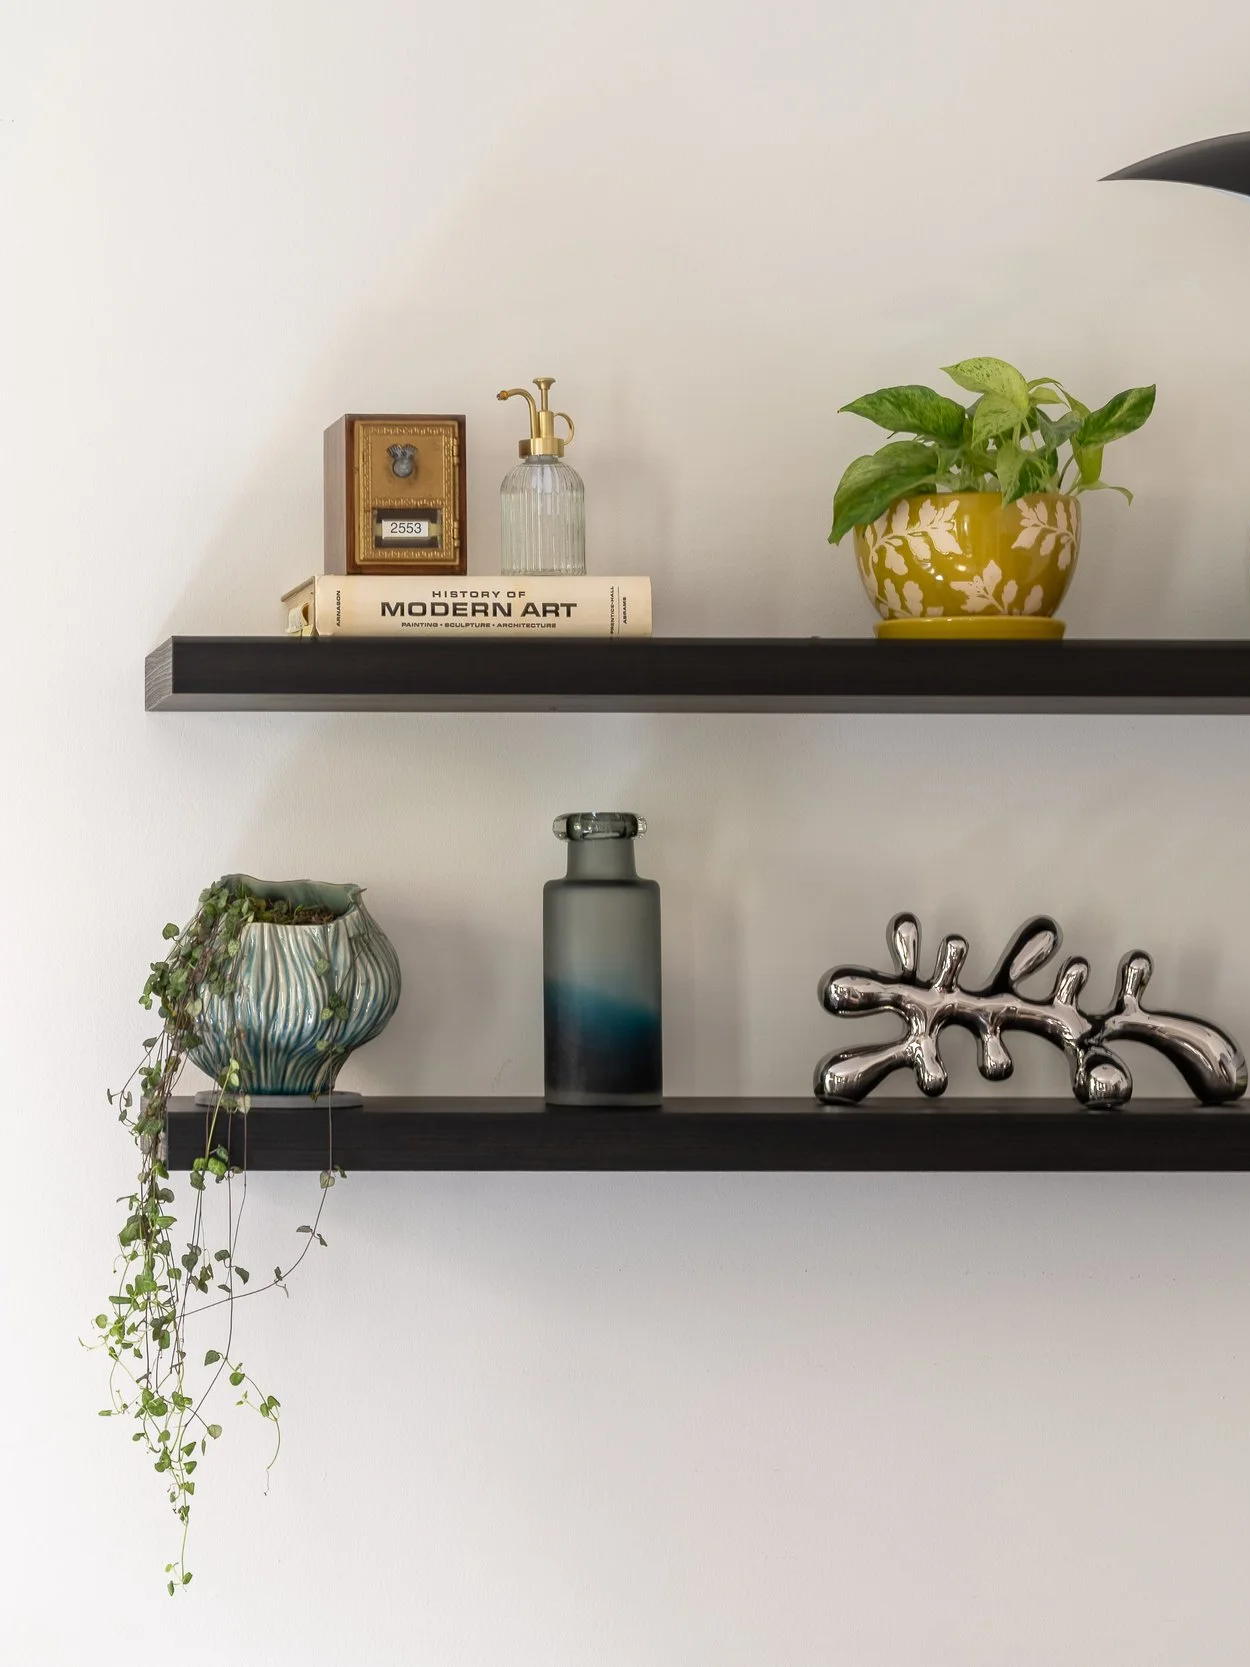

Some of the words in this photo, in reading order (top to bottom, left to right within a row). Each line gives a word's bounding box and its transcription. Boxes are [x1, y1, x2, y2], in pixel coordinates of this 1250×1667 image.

[390, 522, 422, 534] 2553
[432, 590, 501, 598] HISTORY
[506, 590, 526, 599] OF
[381, 602, 512, 617] MODERN
[520, 602, 578, 618] ART
